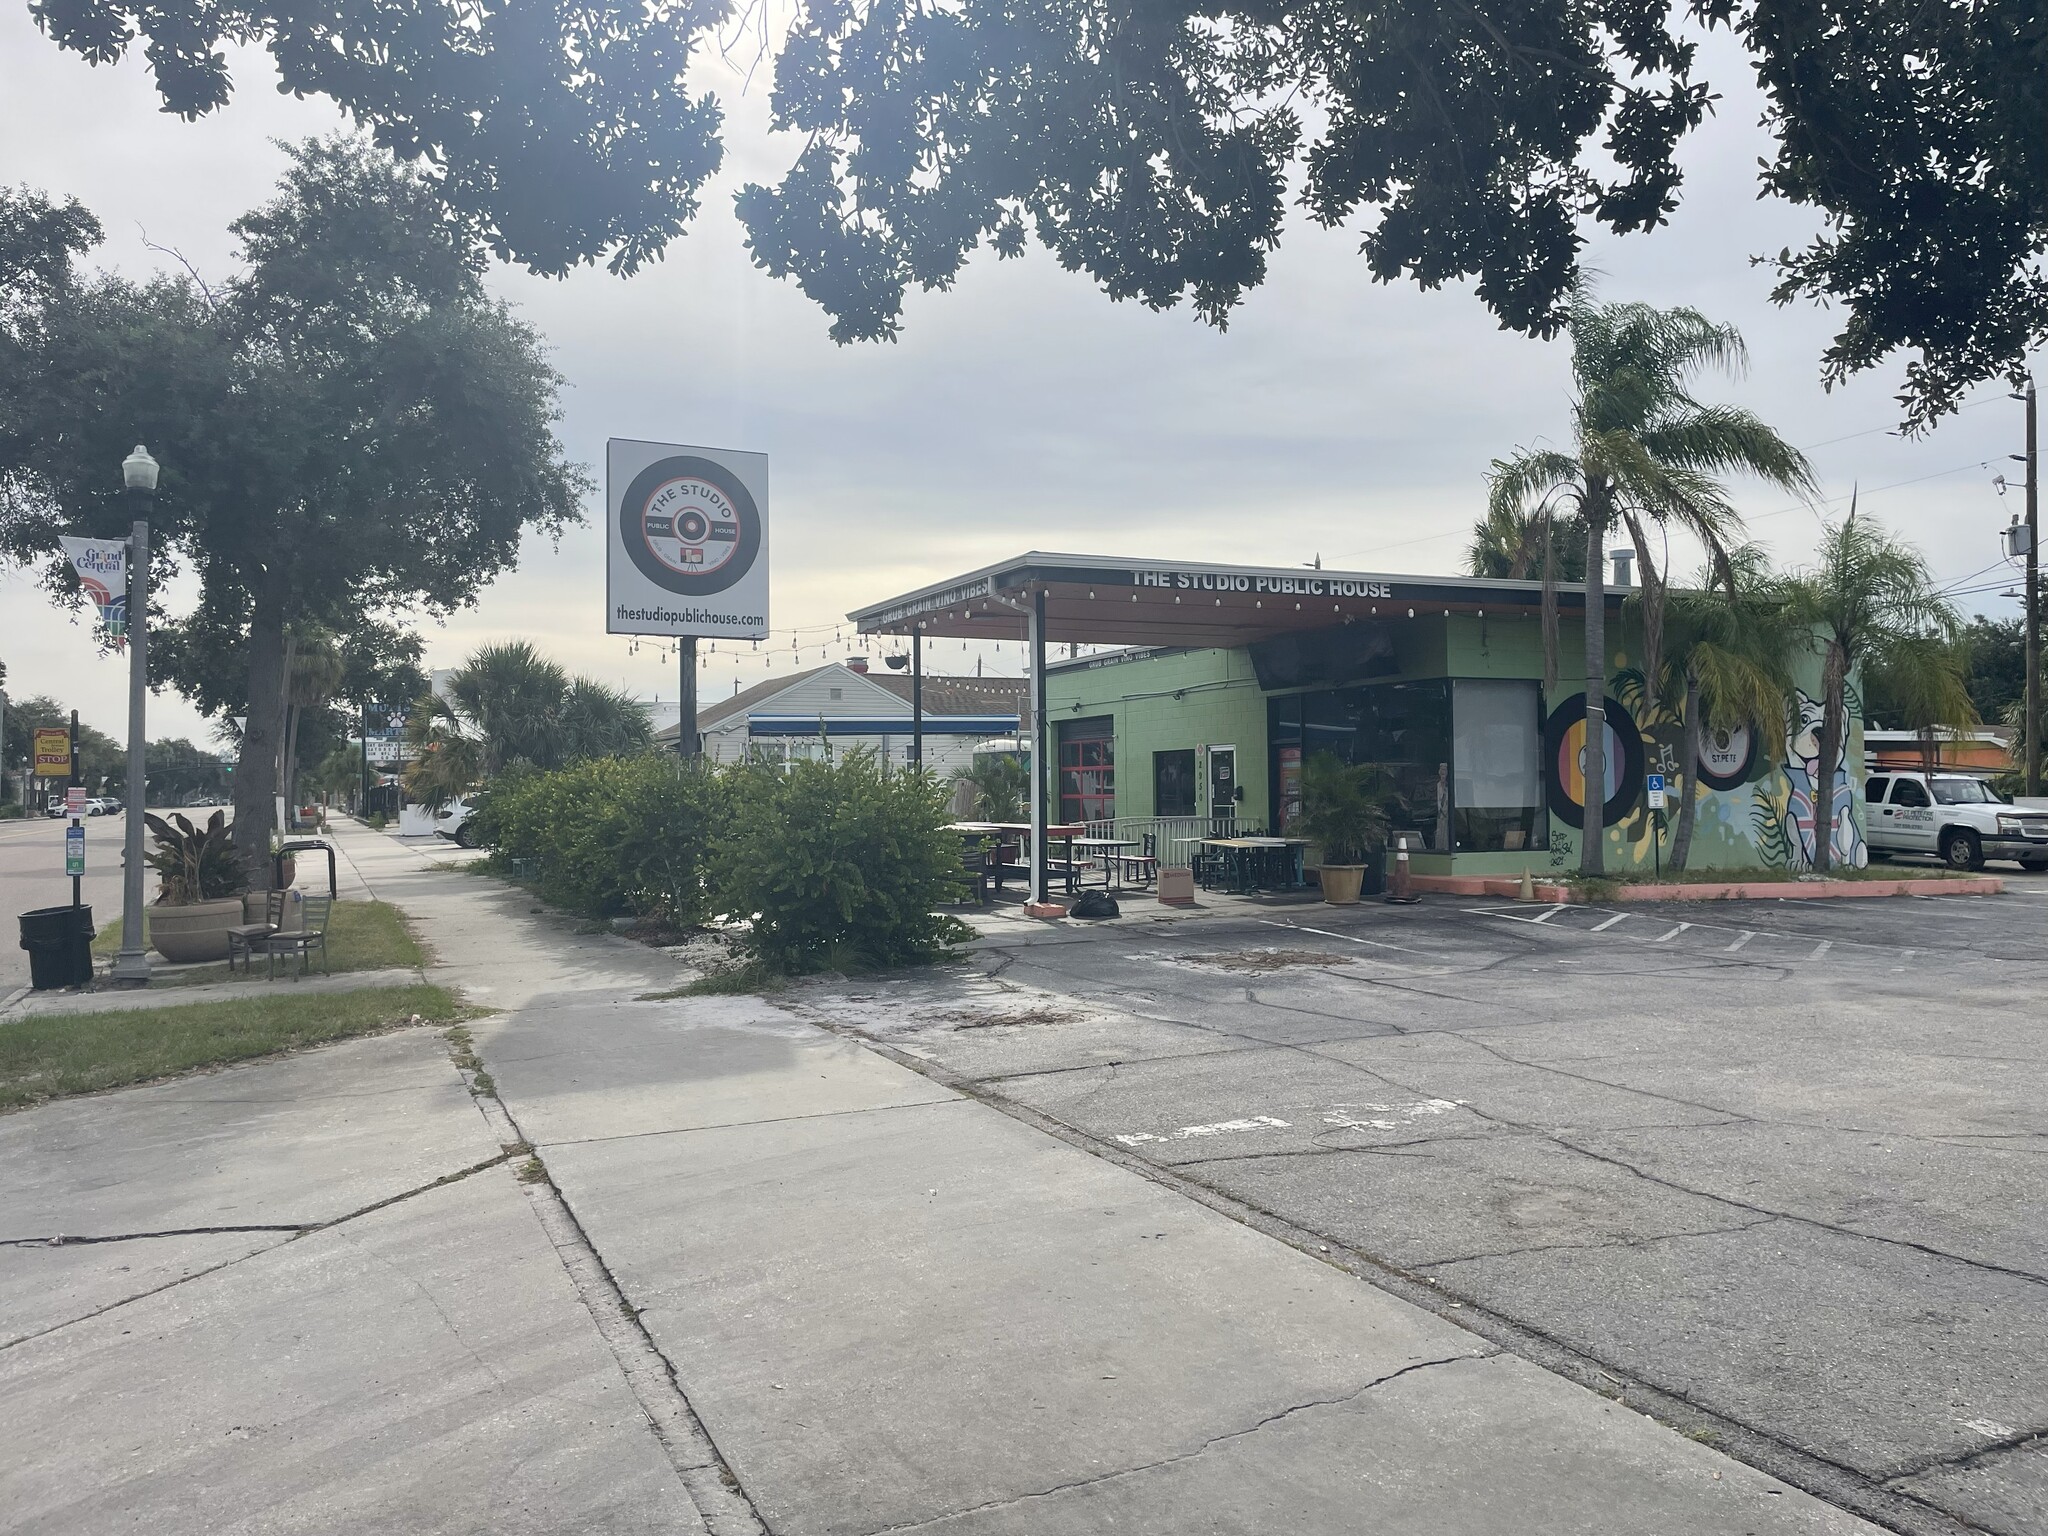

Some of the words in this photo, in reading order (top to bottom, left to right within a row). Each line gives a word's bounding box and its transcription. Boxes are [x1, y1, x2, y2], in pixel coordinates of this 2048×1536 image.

[651, 488, 677, 513] THE
[680, 484, 732, 518] STUDIO
[647, 522, 670, 530] PUBLIC
[714, 527, 736, 535] HOUSE
[76, 556, 120, 573] Central
[85, 548, 122, 563] Grand
[1130, 570, 1170, 588] THE
[1177, 572, 1249, 591] STUDIO
[1256, 575, 1323, 596] PUBLIC
[1330, 579, 1392, 598] HOUSE
[906, 599, 931, 616] GRAIN
[935, 590, 956, 608] VINO
[961, 579, 988, 599] VIBES
[617, 604, 764, 626] thestudiopublichouse.com
[39, 755, 68, 763] STOP
